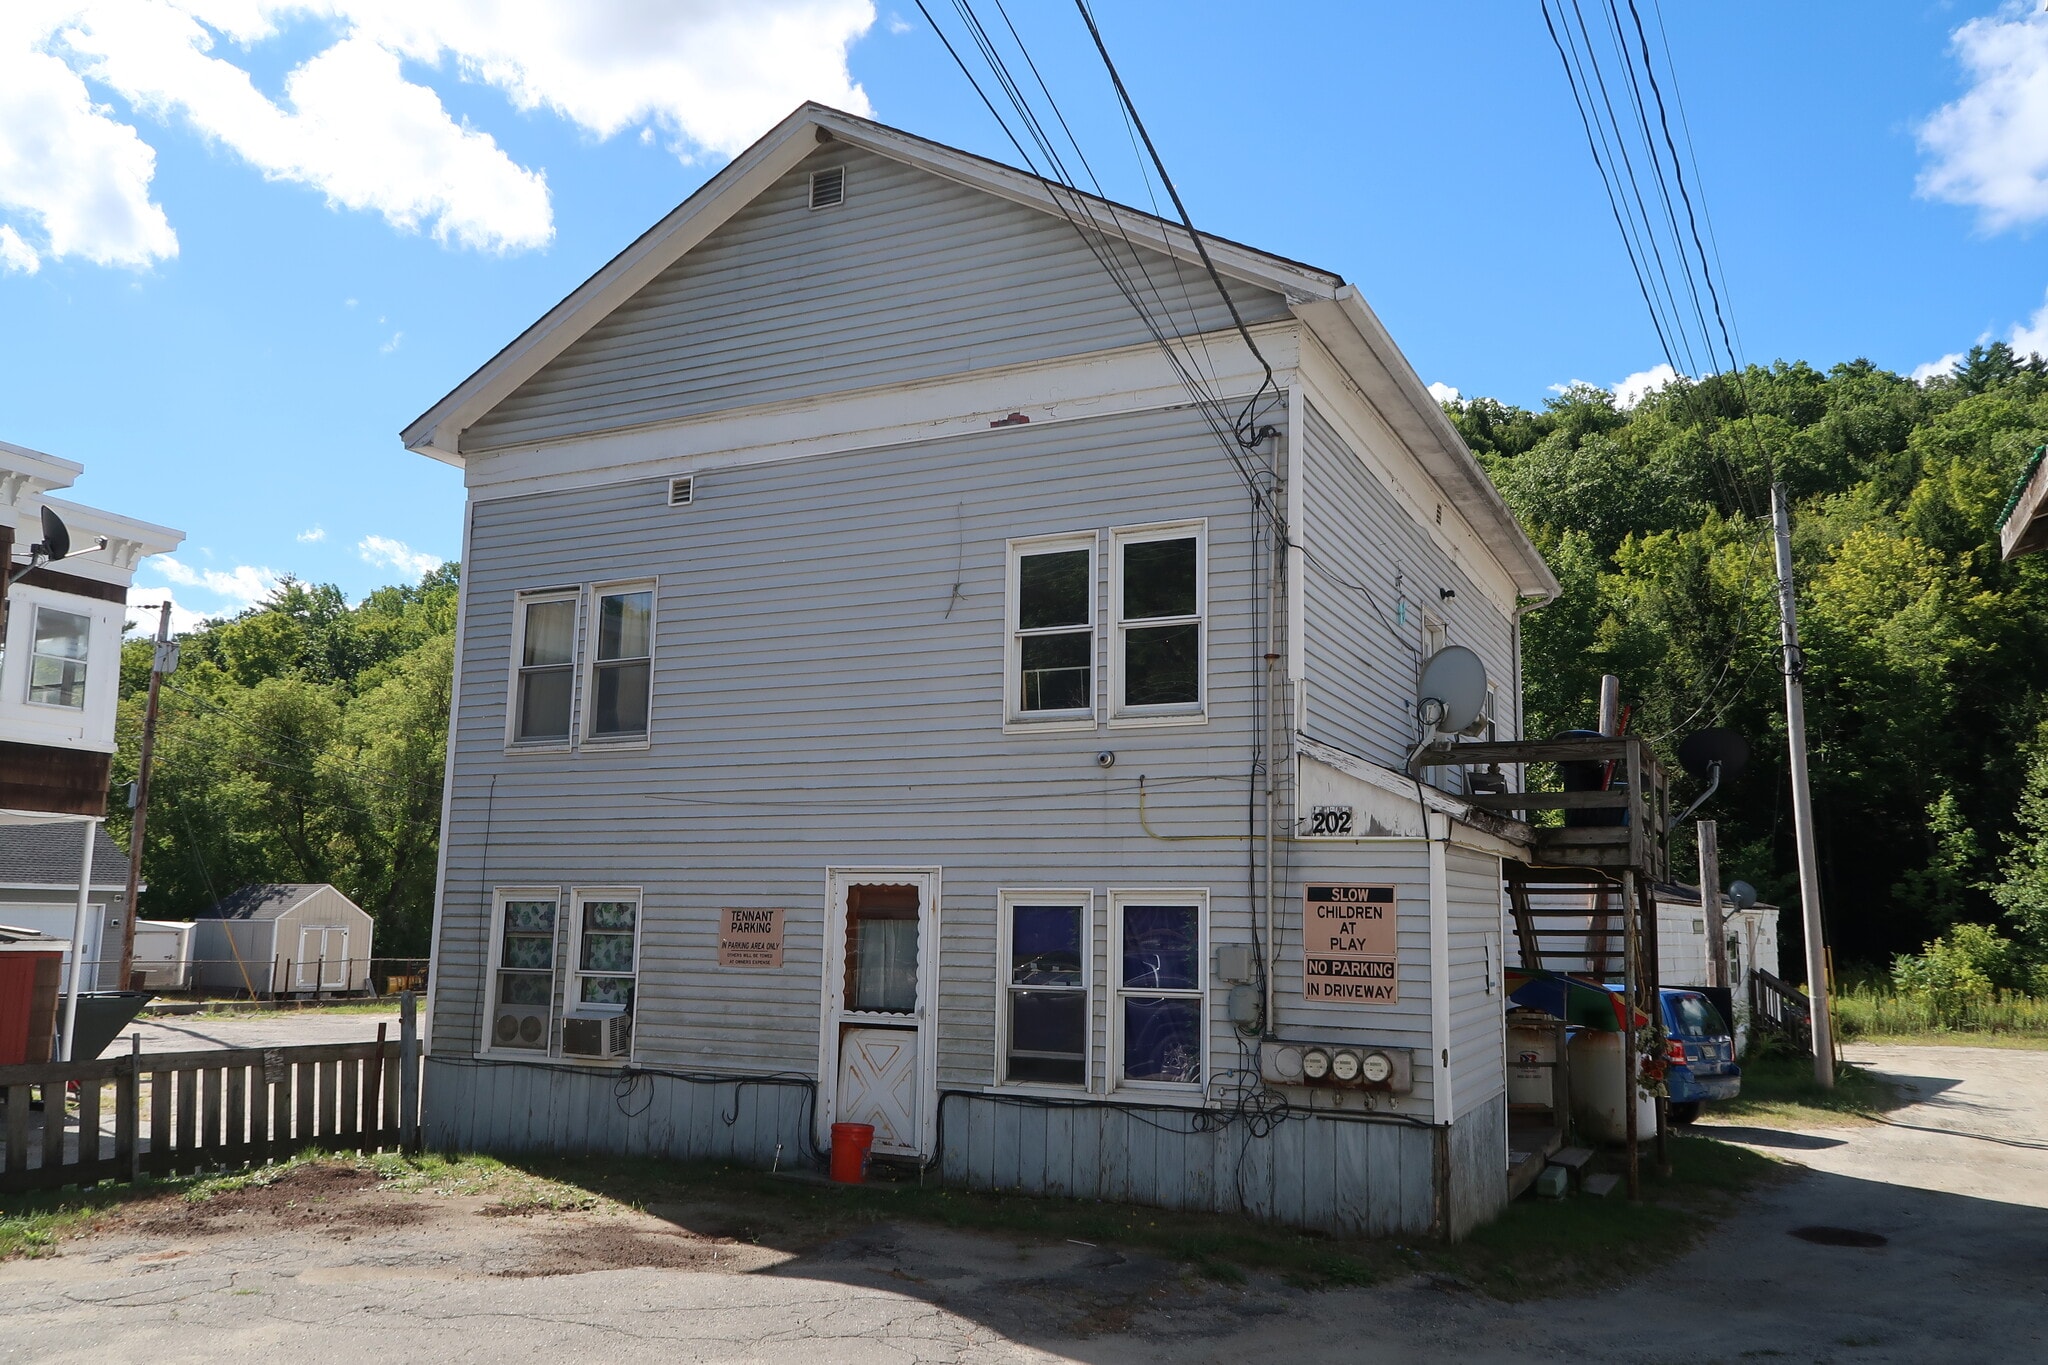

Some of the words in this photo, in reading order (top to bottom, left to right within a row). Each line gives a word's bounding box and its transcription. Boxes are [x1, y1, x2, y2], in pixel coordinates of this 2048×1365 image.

[1313, 811, 1352, 834] 202
[1331, 888, 1369, 902] SLOW
[731, 911, 774, 921] TENNANT
[1317, 905, 1383, 920] CHILDREN
[731, 922, 771, 933] PARKING
[1339, 922, 1357, 935] AT
[728, 941, 750, 949] PARKING
[751, 942, 765, 950] AREA
[767, 942, 780, 950] ONLY
[1330, 937, 1367, 951] PLAY
[1308, 960, 1328, 976] NO
[1332, 962, 1393, 979] PARKING
[1307, 982, 1320, 996] IN
[1324, 983, 1394, 1000] DRIVEWAY
